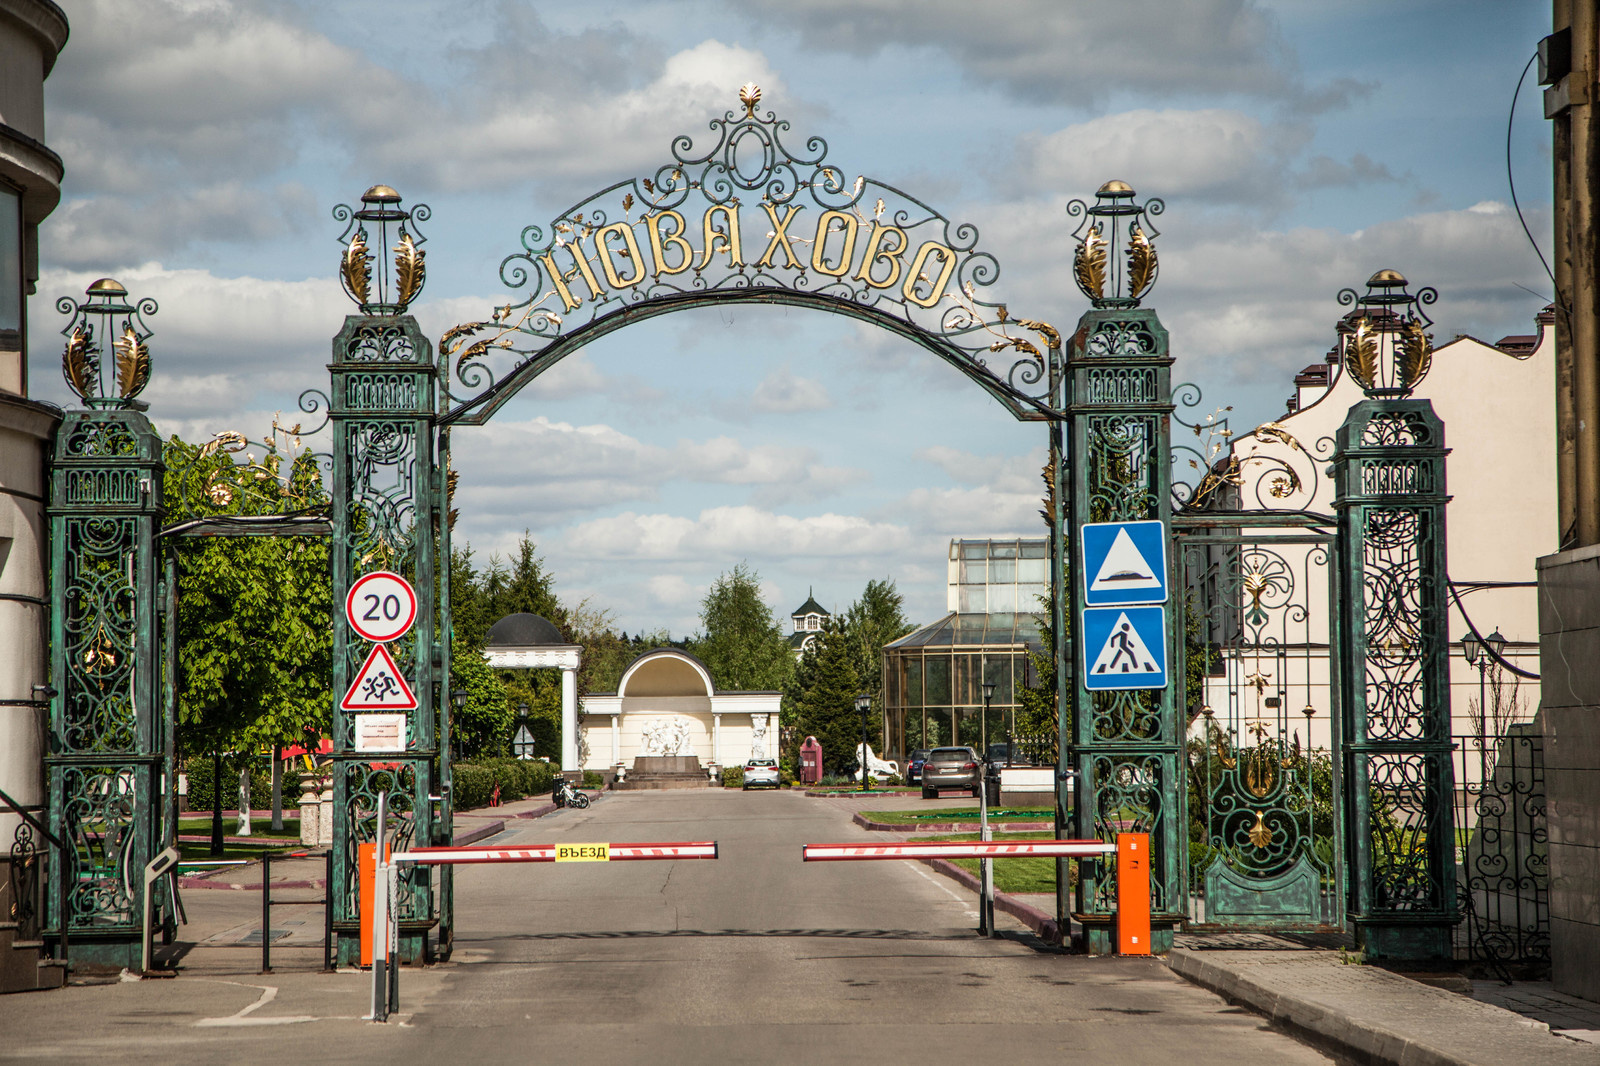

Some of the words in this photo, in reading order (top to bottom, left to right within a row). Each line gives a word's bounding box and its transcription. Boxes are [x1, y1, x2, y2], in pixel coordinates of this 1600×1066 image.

[536, 203, 958, 315] НОВАХОВО
[362, 594, 401, 622] 20
[559, 847, 607, 859] ВЪЕЗД
